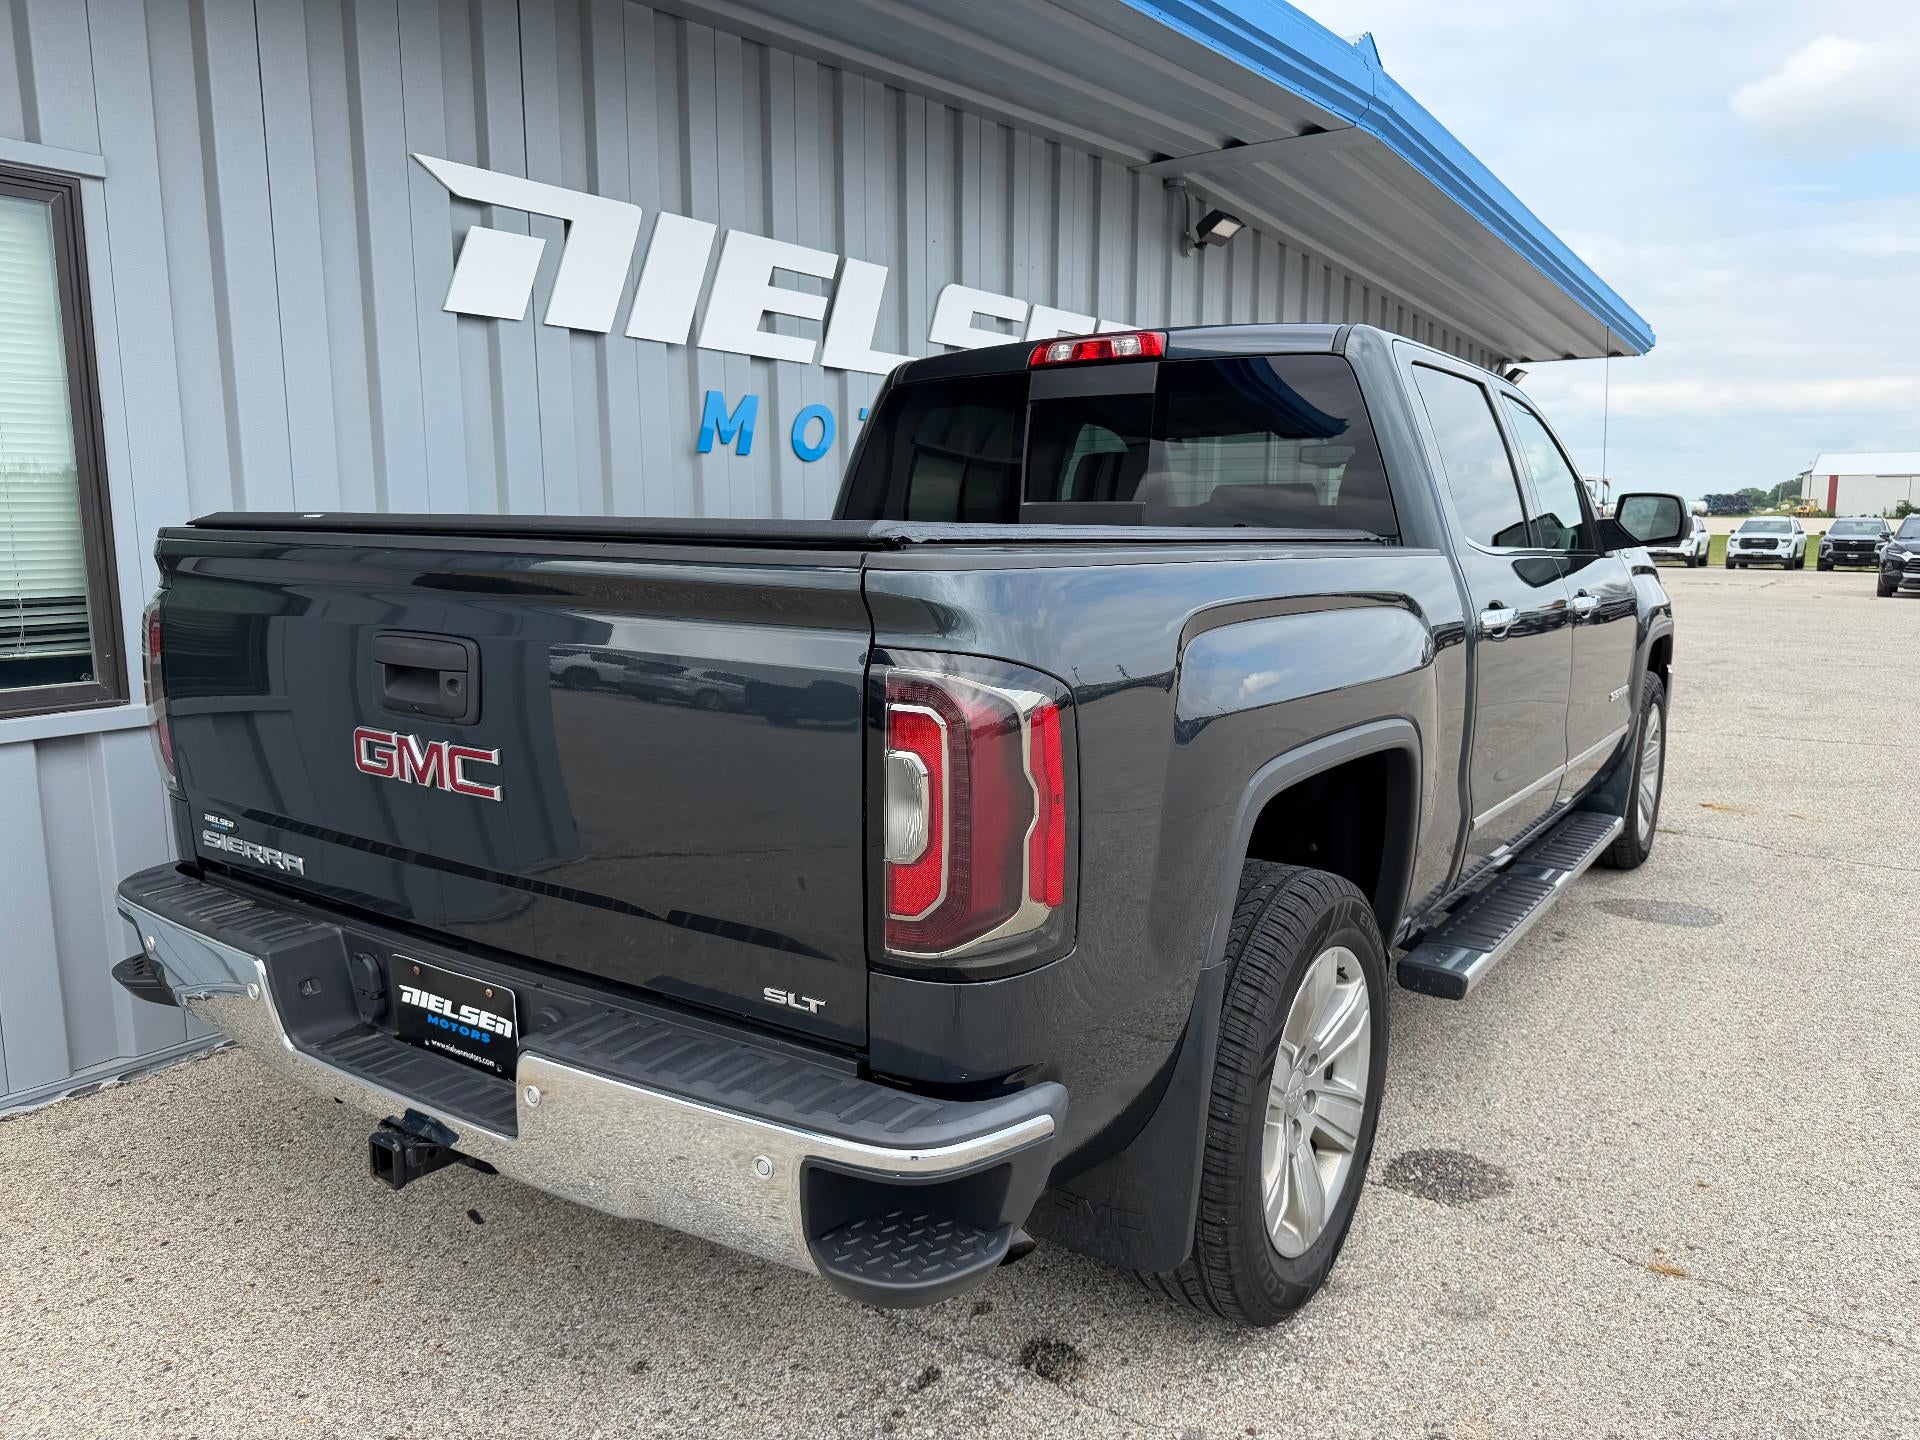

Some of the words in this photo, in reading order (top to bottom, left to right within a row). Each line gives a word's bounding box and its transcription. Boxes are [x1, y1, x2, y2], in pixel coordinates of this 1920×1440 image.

[411, 152, 1147, 376] NIELS
[353, 725, 503, 802] GMC
[202, 829, 305, 876] SIERRA
[399, 984, 513, 1039] NIELSEN
[763, 987, 827, 1015] SLT
[427, 1014, 491, 1044] MOTORS
